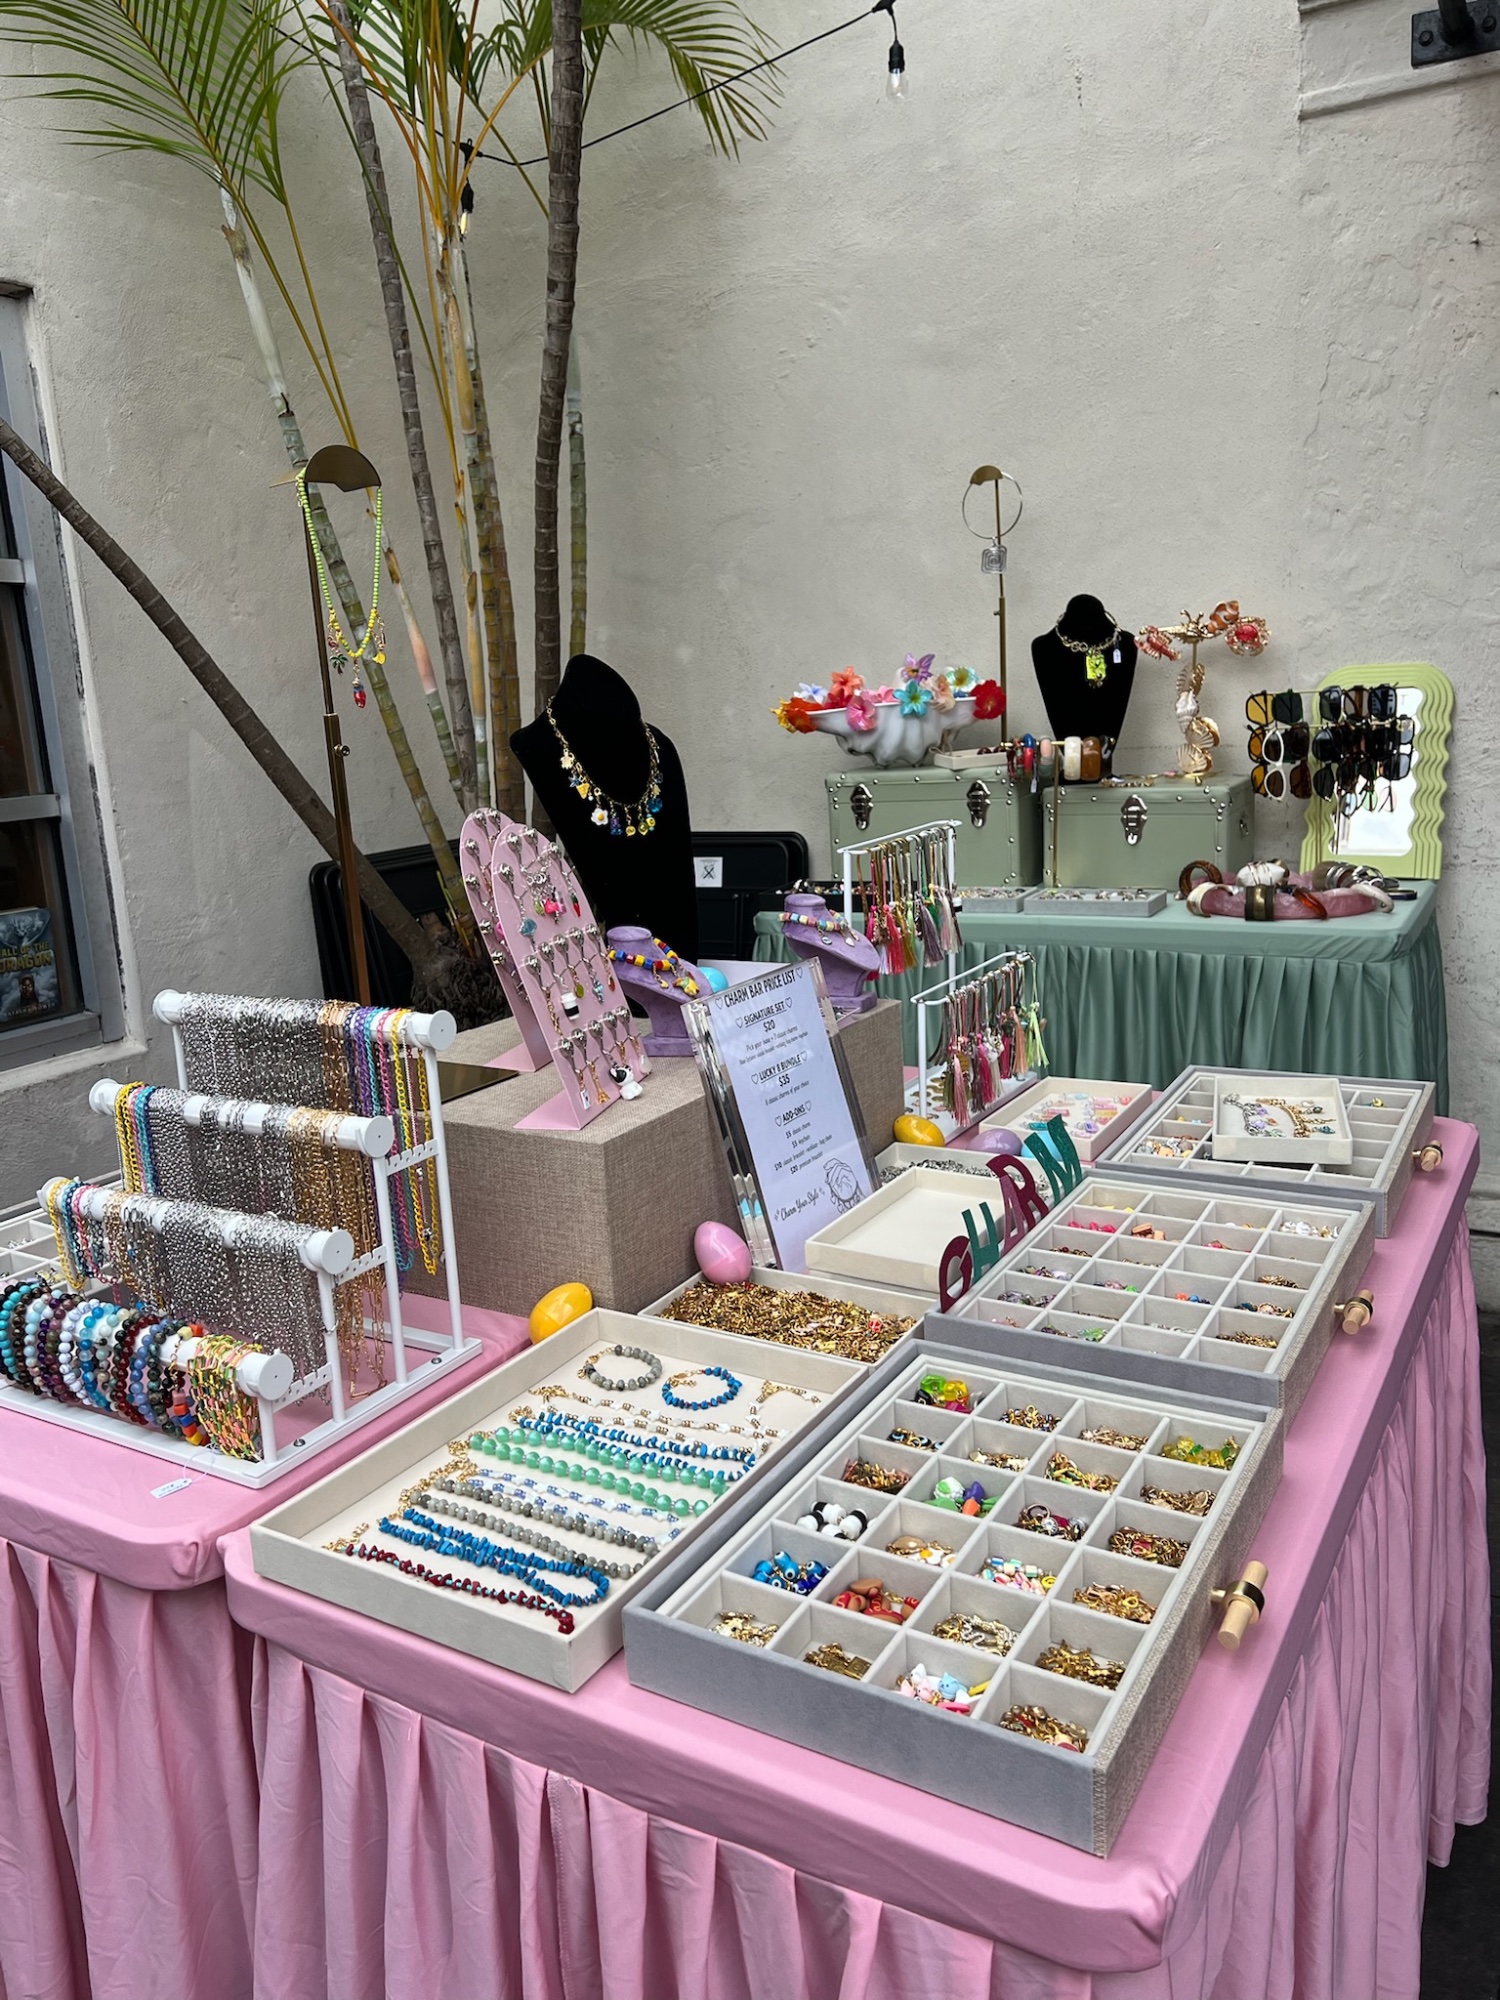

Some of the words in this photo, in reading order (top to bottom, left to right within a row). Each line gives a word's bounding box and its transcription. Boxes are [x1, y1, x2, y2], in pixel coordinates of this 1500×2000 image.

[0, 947, 18, 958] ALL
[21, 944, 30, 954] OF
[34, 942, 49, 951] THE
[724, 988, 750, 1008] CHARM
[748, 982, 764, 999] BAR
[764, 974, 783, 992] PRICE
[782, 969, 796, 985] LIST
[744, 1006, 775, 1025] SIGNATURE
[774, 1001, 785, 1013] SET
[763, 1019, 776, 1032] $20
[759, 1065, 776, 1081] LUCKY
[776, 1063, 781, 1072] 8
[780, 1054, 801, 1070] BUNDLE
[778, 1073, 790, 1087] $35
[782, 1104, 806, 1122] ADD-ONS
[790, 1164, 798, 1175] $20
[781, 1207, 797, 1221] Charm
[795, 1198, 808, 1214] Your
